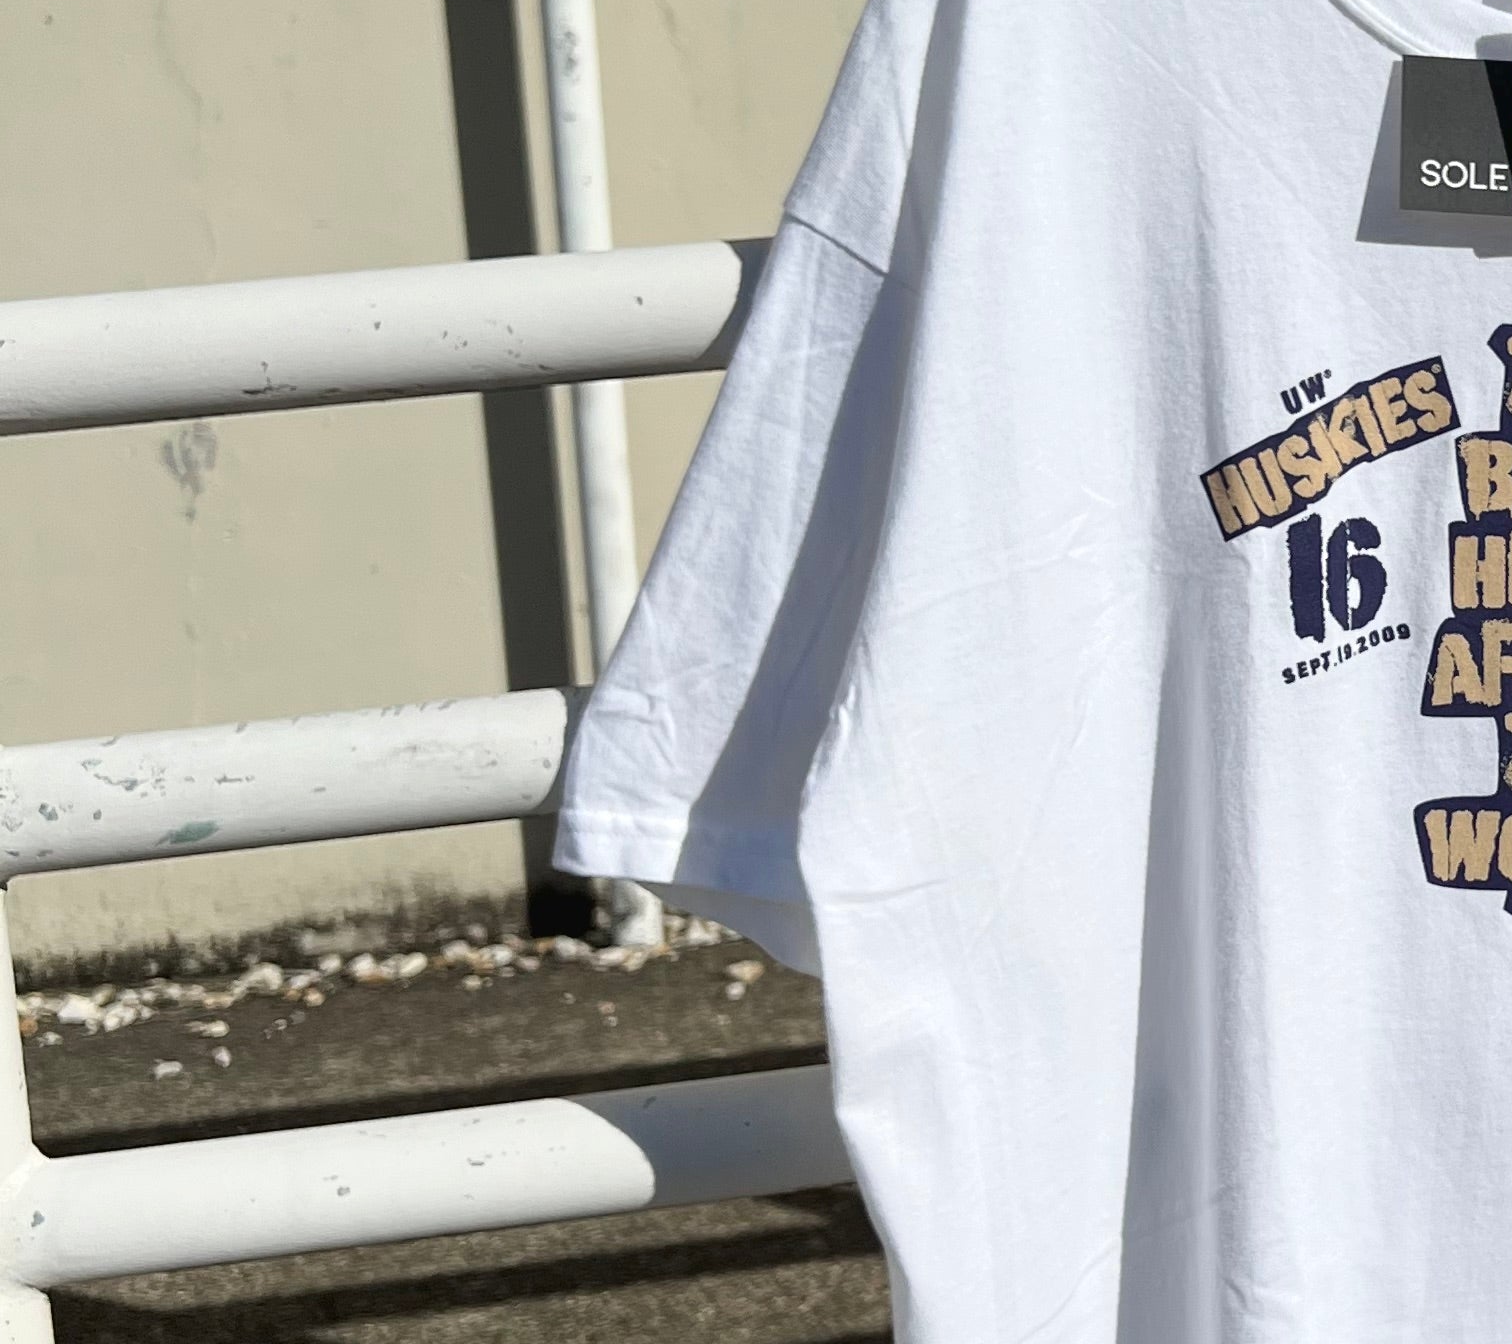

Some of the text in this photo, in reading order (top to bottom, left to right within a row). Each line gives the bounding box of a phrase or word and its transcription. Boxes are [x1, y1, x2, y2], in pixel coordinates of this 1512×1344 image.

[1420, 159, 1509, 191] SOLE
[1205, 369, 1453, 535] HUSKIES
[1286, 512, 1388, 644] 16
